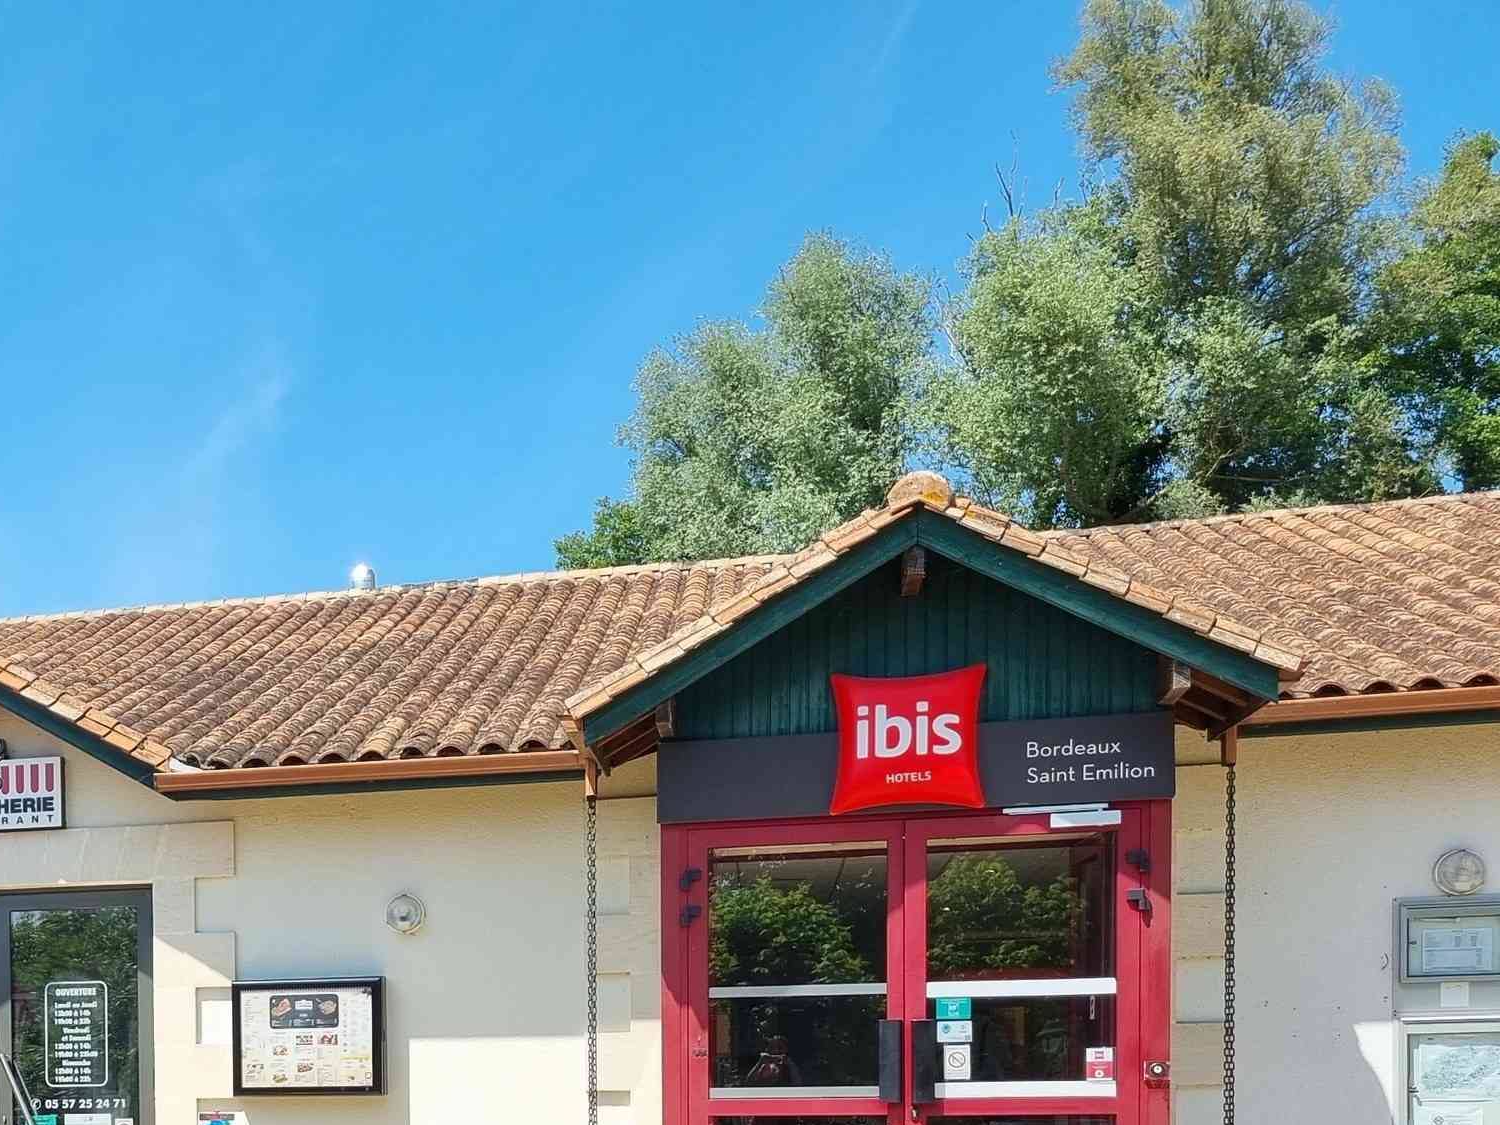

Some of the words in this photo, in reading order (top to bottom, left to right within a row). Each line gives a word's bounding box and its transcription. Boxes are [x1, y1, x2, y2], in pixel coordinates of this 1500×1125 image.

[856, 701, 962, 759] ibis
[1026, 739, 1122, 759] Bordeaux
[885, 770, 932, 784] HOTELS
[1026, 764, 1076, 785] Saint
[1082, 762, 1155, 782] Emilion
[55, 987, 97, 996] OUVERTURE
[45, 1099, 59, 1109] 05
[61, 1099, 76, 1109] 57
[79, 1099, 93, 1109] 25
[95, 1099, 110, 1109] 24
[113, 1098, 126, 1108] 71
